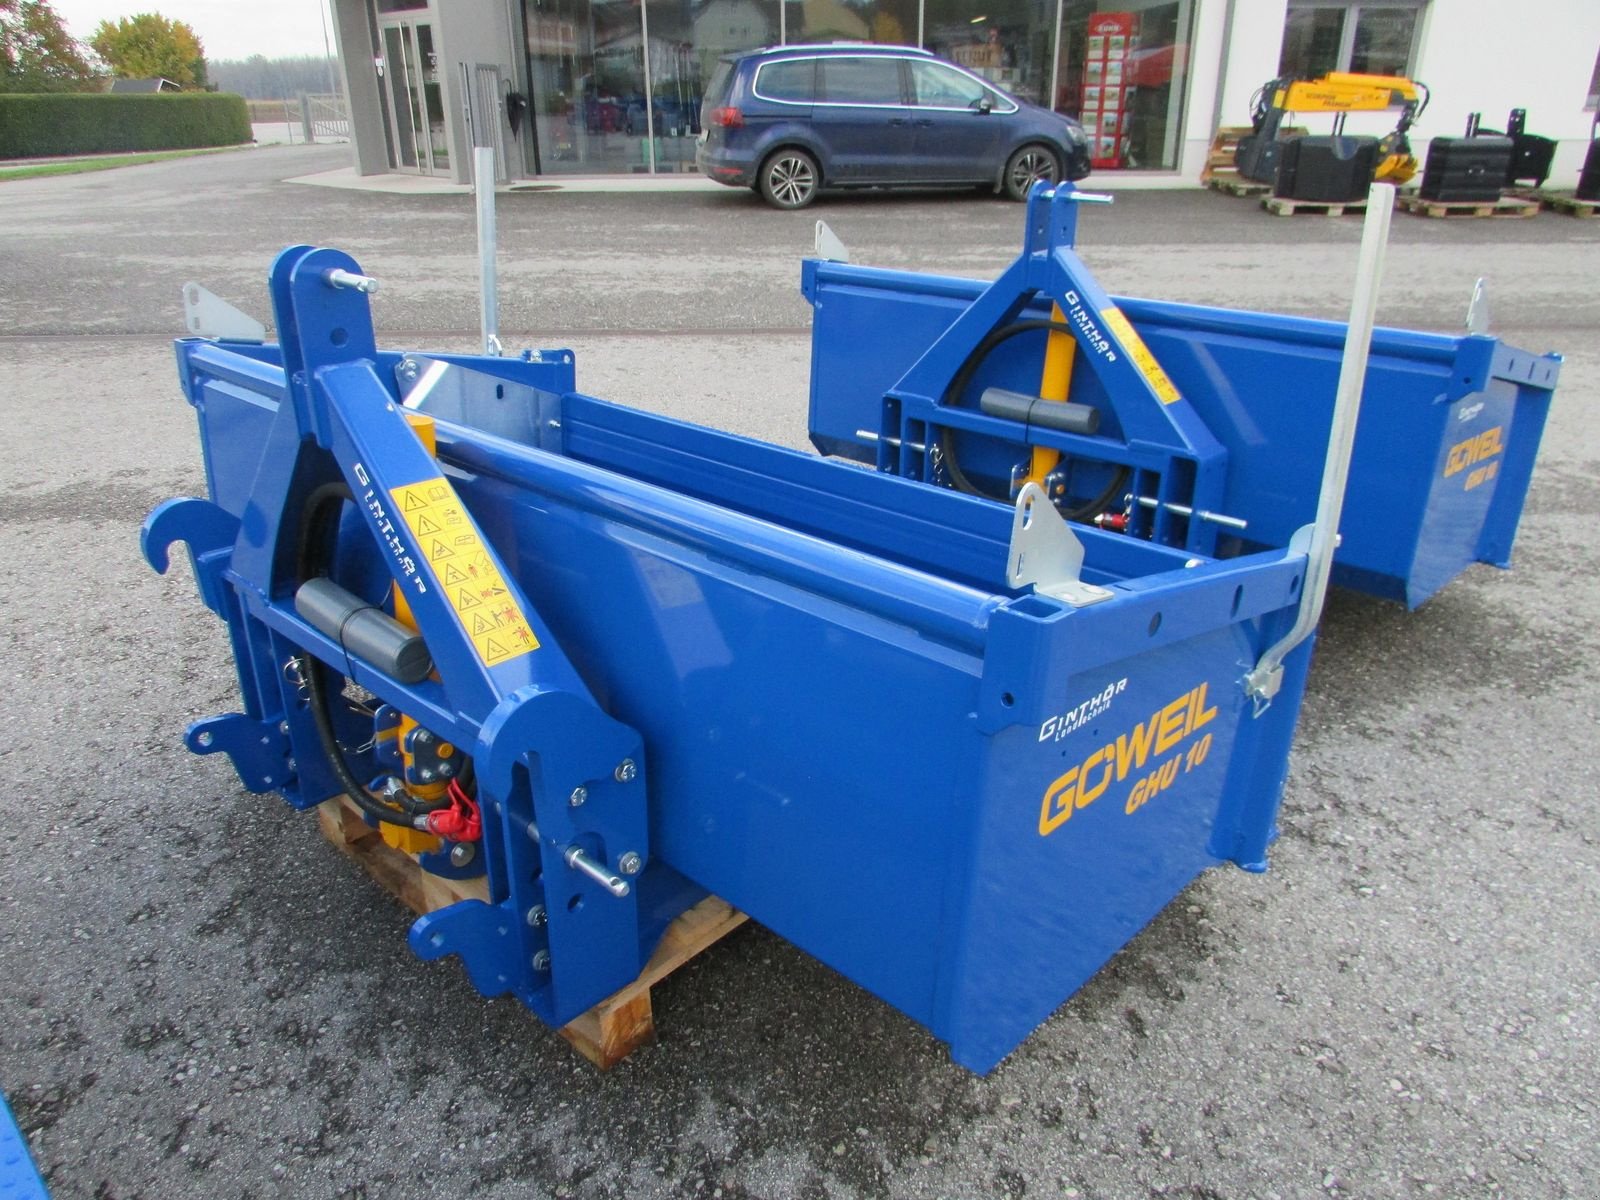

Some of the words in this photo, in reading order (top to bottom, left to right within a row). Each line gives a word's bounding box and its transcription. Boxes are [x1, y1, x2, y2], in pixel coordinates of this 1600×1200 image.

[1038, 677, 1128, 742] GINTHÖR
[1125, 752, 1182, 815] GHU
[1184, 733, 1214, 773] 10
